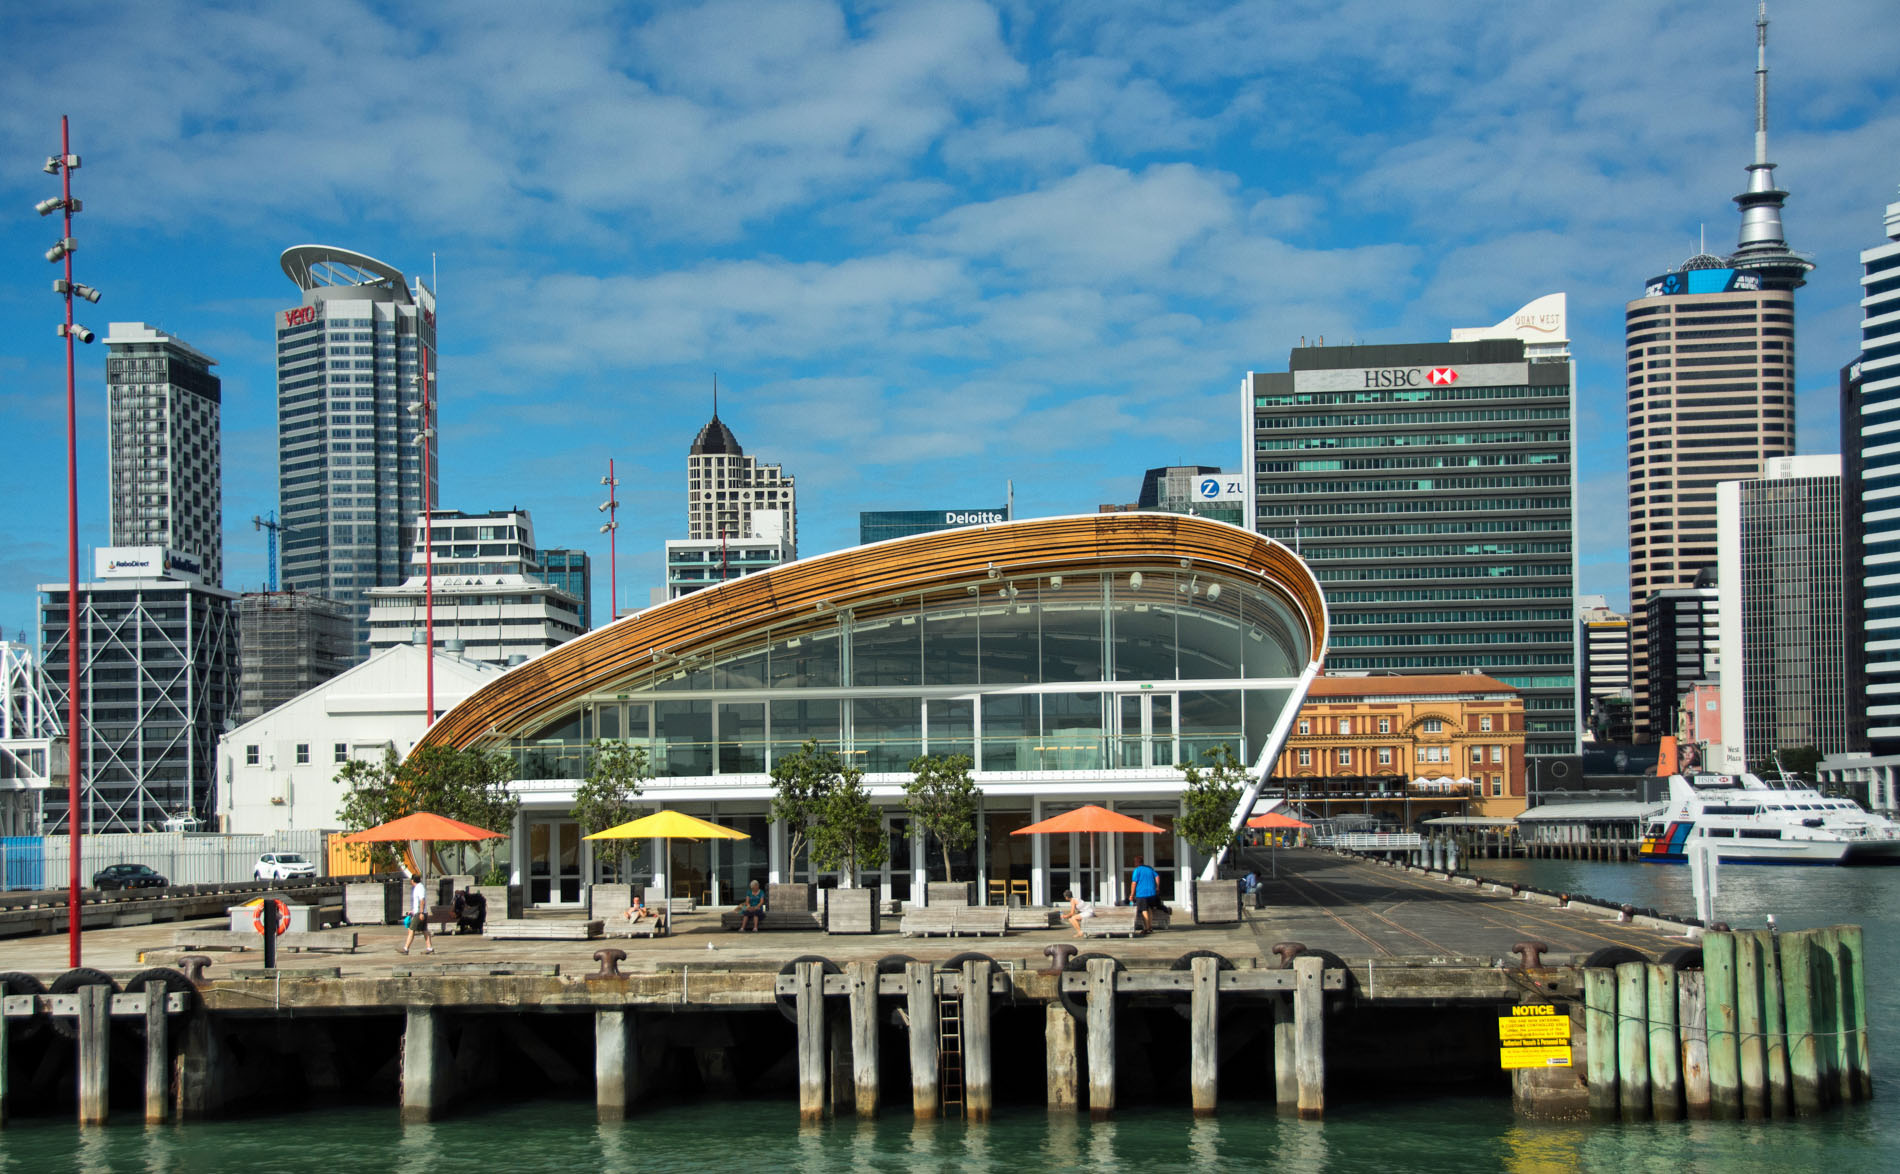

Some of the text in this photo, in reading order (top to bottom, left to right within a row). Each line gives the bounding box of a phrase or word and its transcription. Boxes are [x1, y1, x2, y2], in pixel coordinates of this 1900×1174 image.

[285, 305, 315, 327] vero
[1515, 313, 1560, 325] QUAY WEST
[1364, 368, 1421, 388] HSBC
[946, 512, 1003, 524] Deloitte
[1660, 752, 1667, 765] 2
[1512, 1005, 1555, 1016] NOTICE
